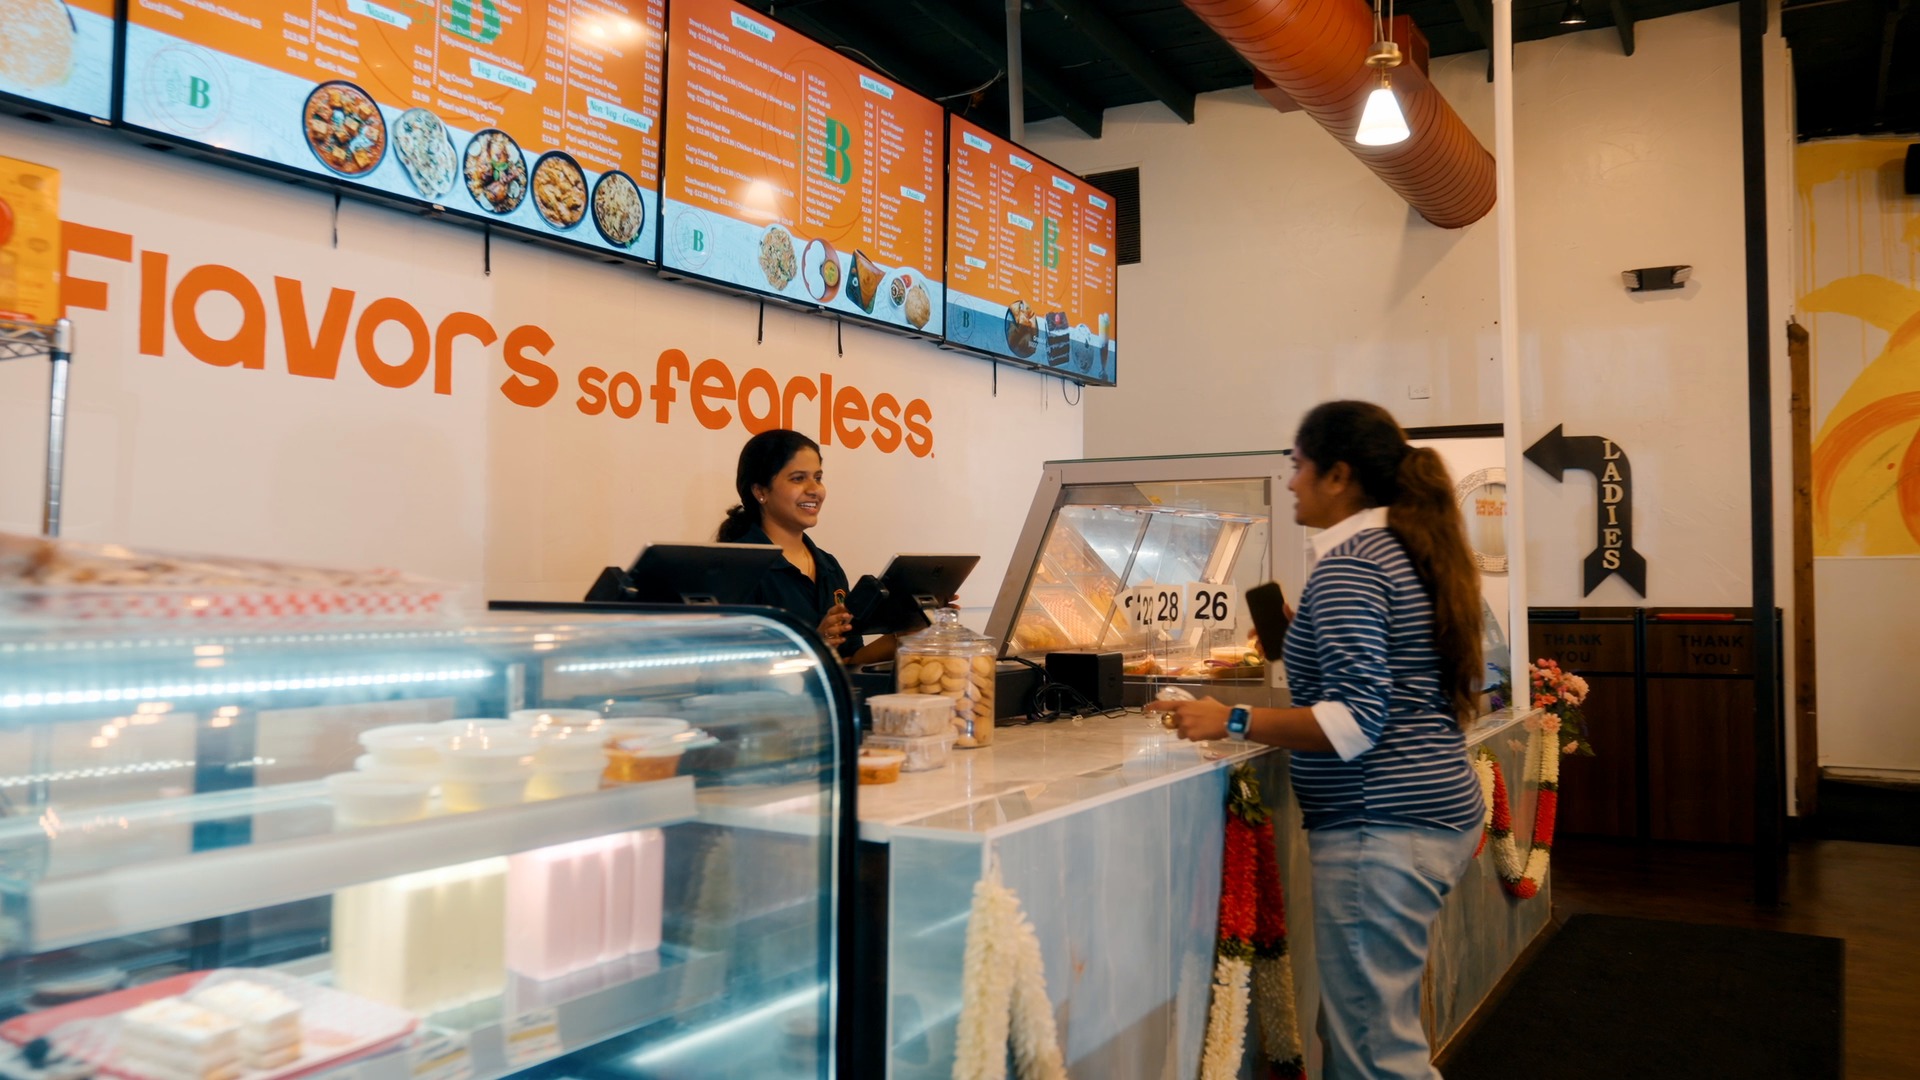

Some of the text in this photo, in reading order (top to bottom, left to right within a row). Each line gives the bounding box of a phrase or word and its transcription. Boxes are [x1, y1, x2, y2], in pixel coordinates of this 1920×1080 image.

[338, 16, 356, 30] Naan
[340, 33, 359, 47] Naan
[712, 28, 729, 42] Noodles
[339, 49, 359, 63] Naan
[738, 51, 753, 63] Chicken
[501, 56, 523, 71] Chicken
[709, 58, 725, 71] Noodles
[338, 65, 357, 79] Naan
[498, 71, 528, 90] Combos
[190, 75, 210, 109] B
[711, 90, 727, 102] Noodles
[590, 100, 646, 129] Non Veg Combos
[721, 125, 730, 134] Rice
[597, 132, 617, 145] Chicken
[588, 141, 608, 154] Chicken
[609, 148, 622, 160] Curry
[685, 143, 717, 161] Curry Fried Rice
[826, 116, 852, 185] B
[606, 159, 619, 170] Curry
[706, 182, 716, 191] Fried
[716, 186, 725, 194] Rice
[823, 182, 836, 192] Chicken
[836, 186, 845, 196] Curry
[693, 229, 704, 252] B
[963, 311, 970, 328] B
[576, 365, 641, 420] so
[1602, 438, 1624, 570] LADIES
[1158, 591, 1178, 622] 28
[1194, 590, 1228, 622] 26
[1543, 633, 1603, 646] THANK
[1679, 634, 1744, 648] THANK
[1691, 652, 1732, 666] YOU
